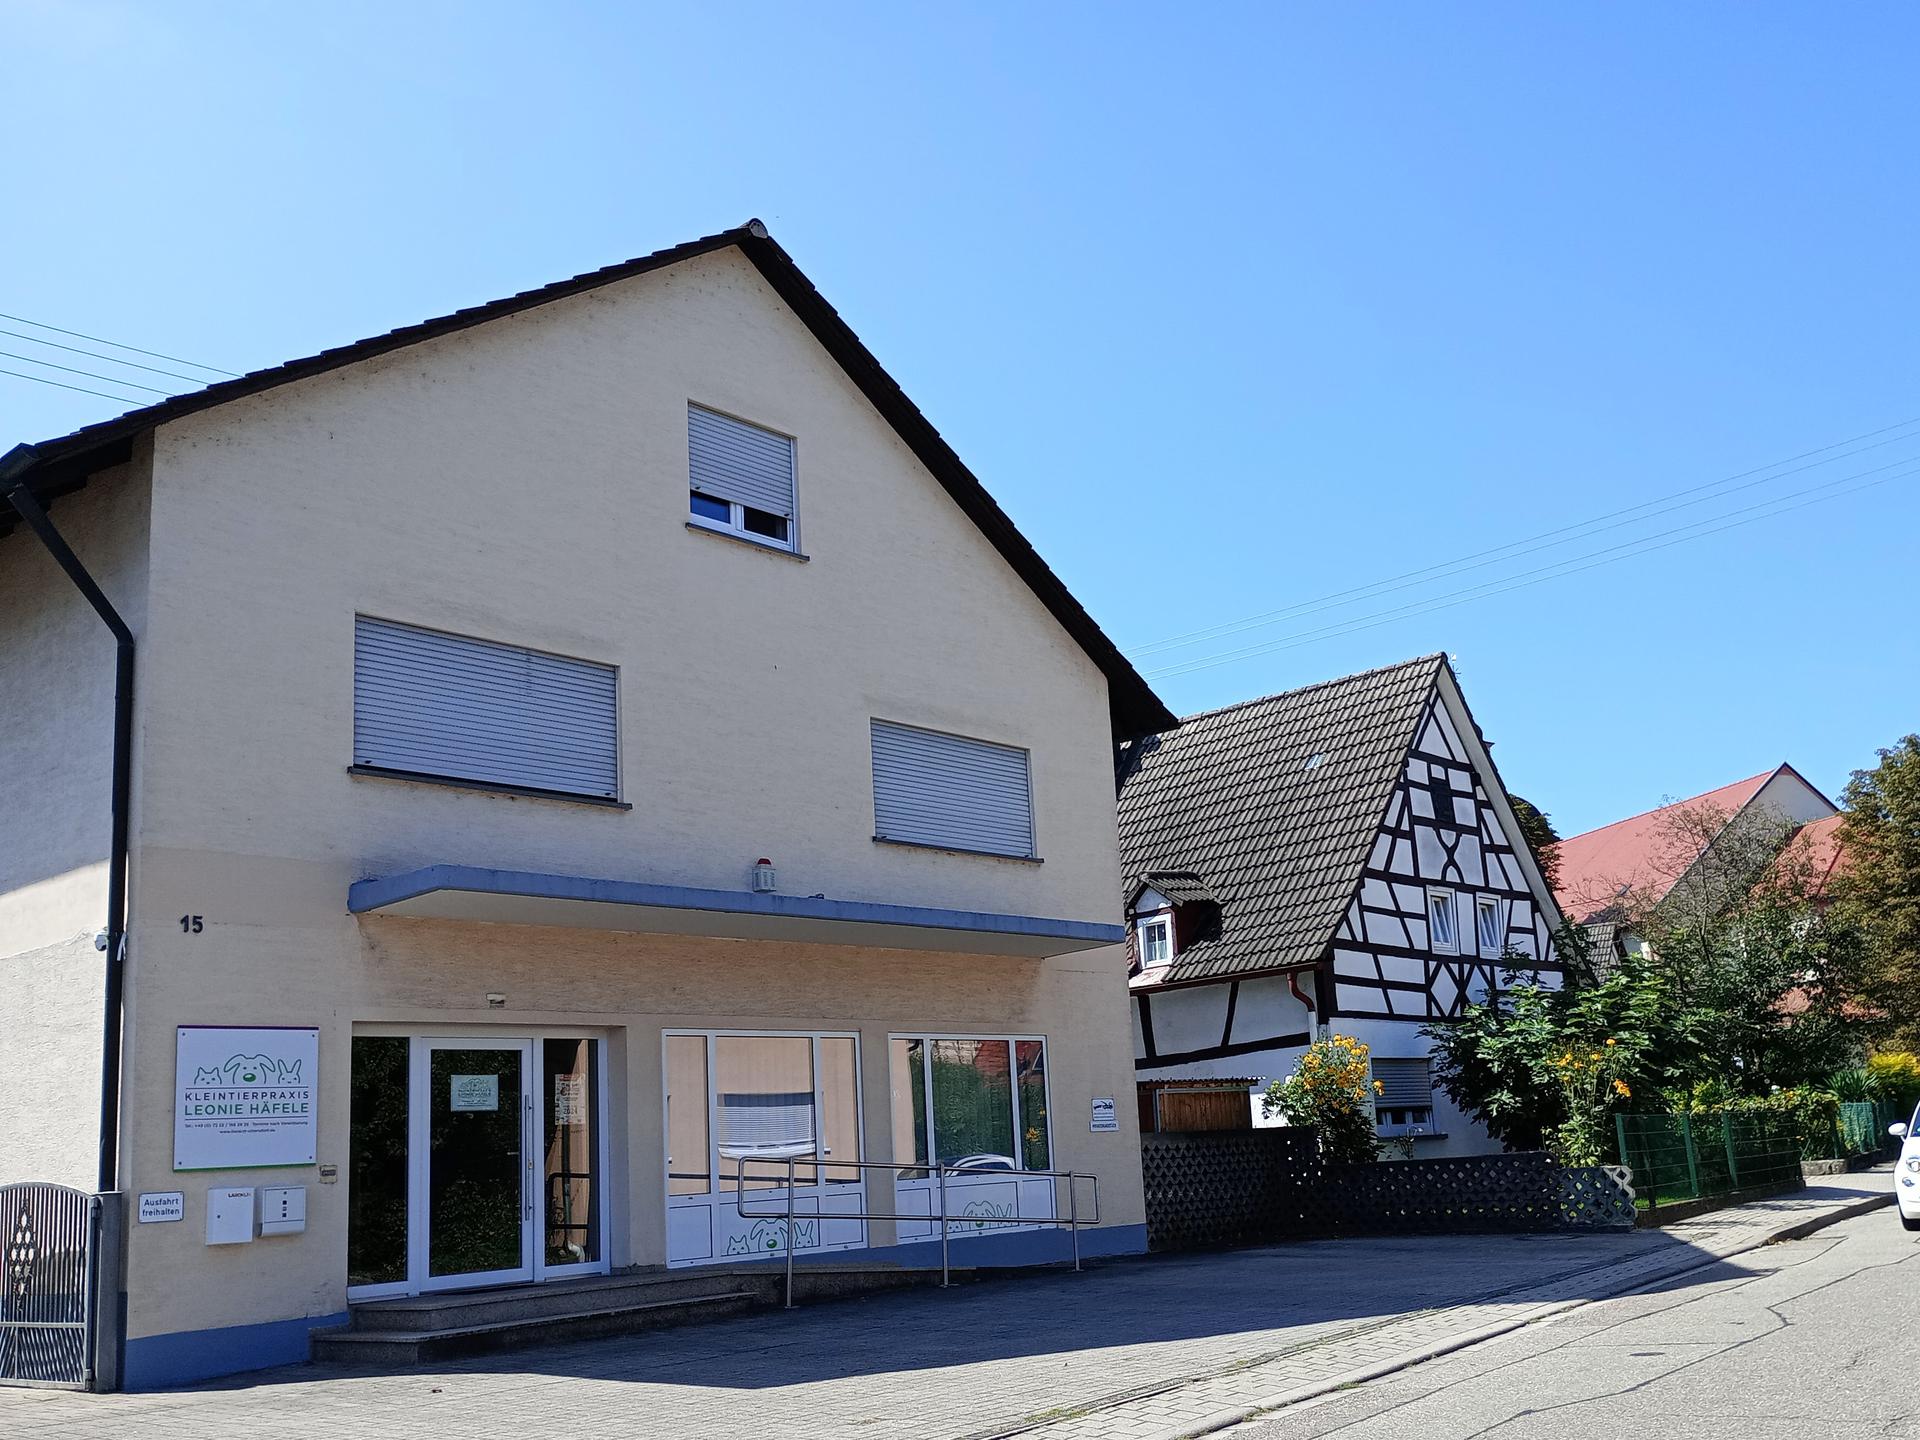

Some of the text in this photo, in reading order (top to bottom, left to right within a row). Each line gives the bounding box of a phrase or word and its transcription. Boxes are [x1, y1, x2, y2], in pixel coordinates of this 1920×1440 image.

[180, 914, 204, 934] 15
[185, 1091, 309, 1101] KLEINTIERPRAXIS
[184, 1101, 309, 1116] LEONIE HÄFELE
[143, 1198, 179, 1207] Ausfahrt
[142, 1209, 180, 1217] freihalten
